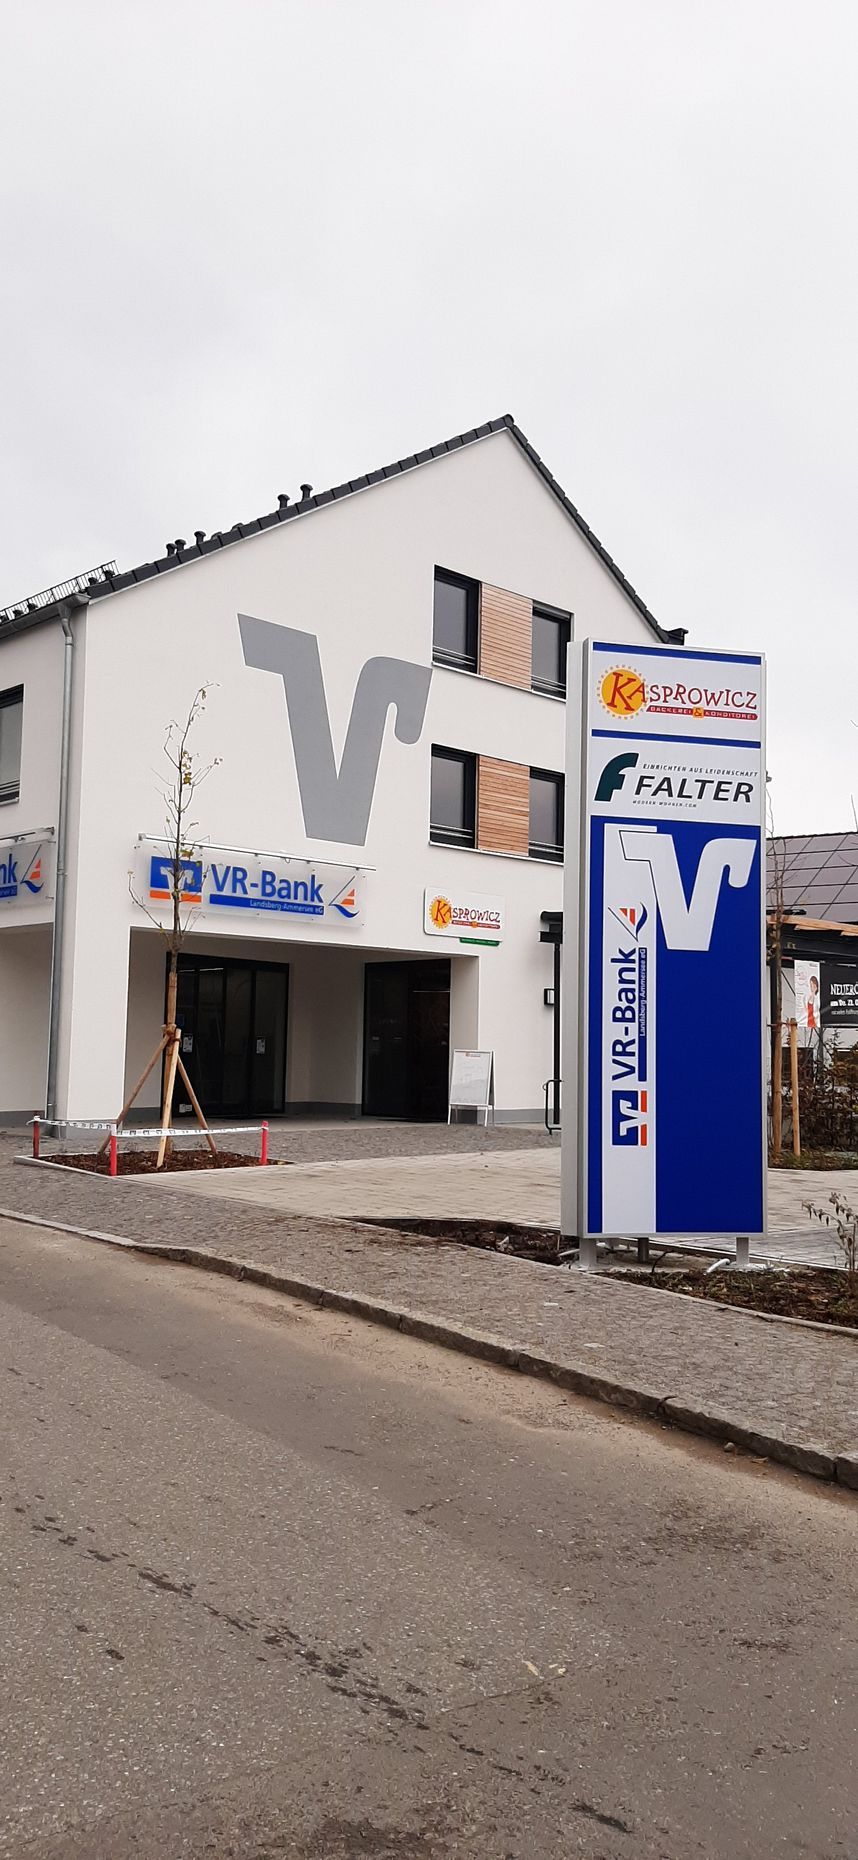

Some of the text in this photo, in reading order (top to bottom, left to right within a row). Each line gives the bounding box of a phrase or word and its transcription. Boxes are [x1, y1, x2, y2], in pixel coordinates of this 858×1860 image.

[607, 672, 757, 710] KASPROWICZ
[694, 707, 703, 717] &
[643, 763, 687, 772] EINRICHTEN
[705, 768, 758, 777] LEIDENSCHAFT
[635, 775, 754, 802] FALTER
[211, 864, 324, 903] VR-Bank
[434, 900, 500, 923] KASPROWICZ
[639, 948, 646, 957] eG
[611, 948, 636, 1081] VR-Bank
